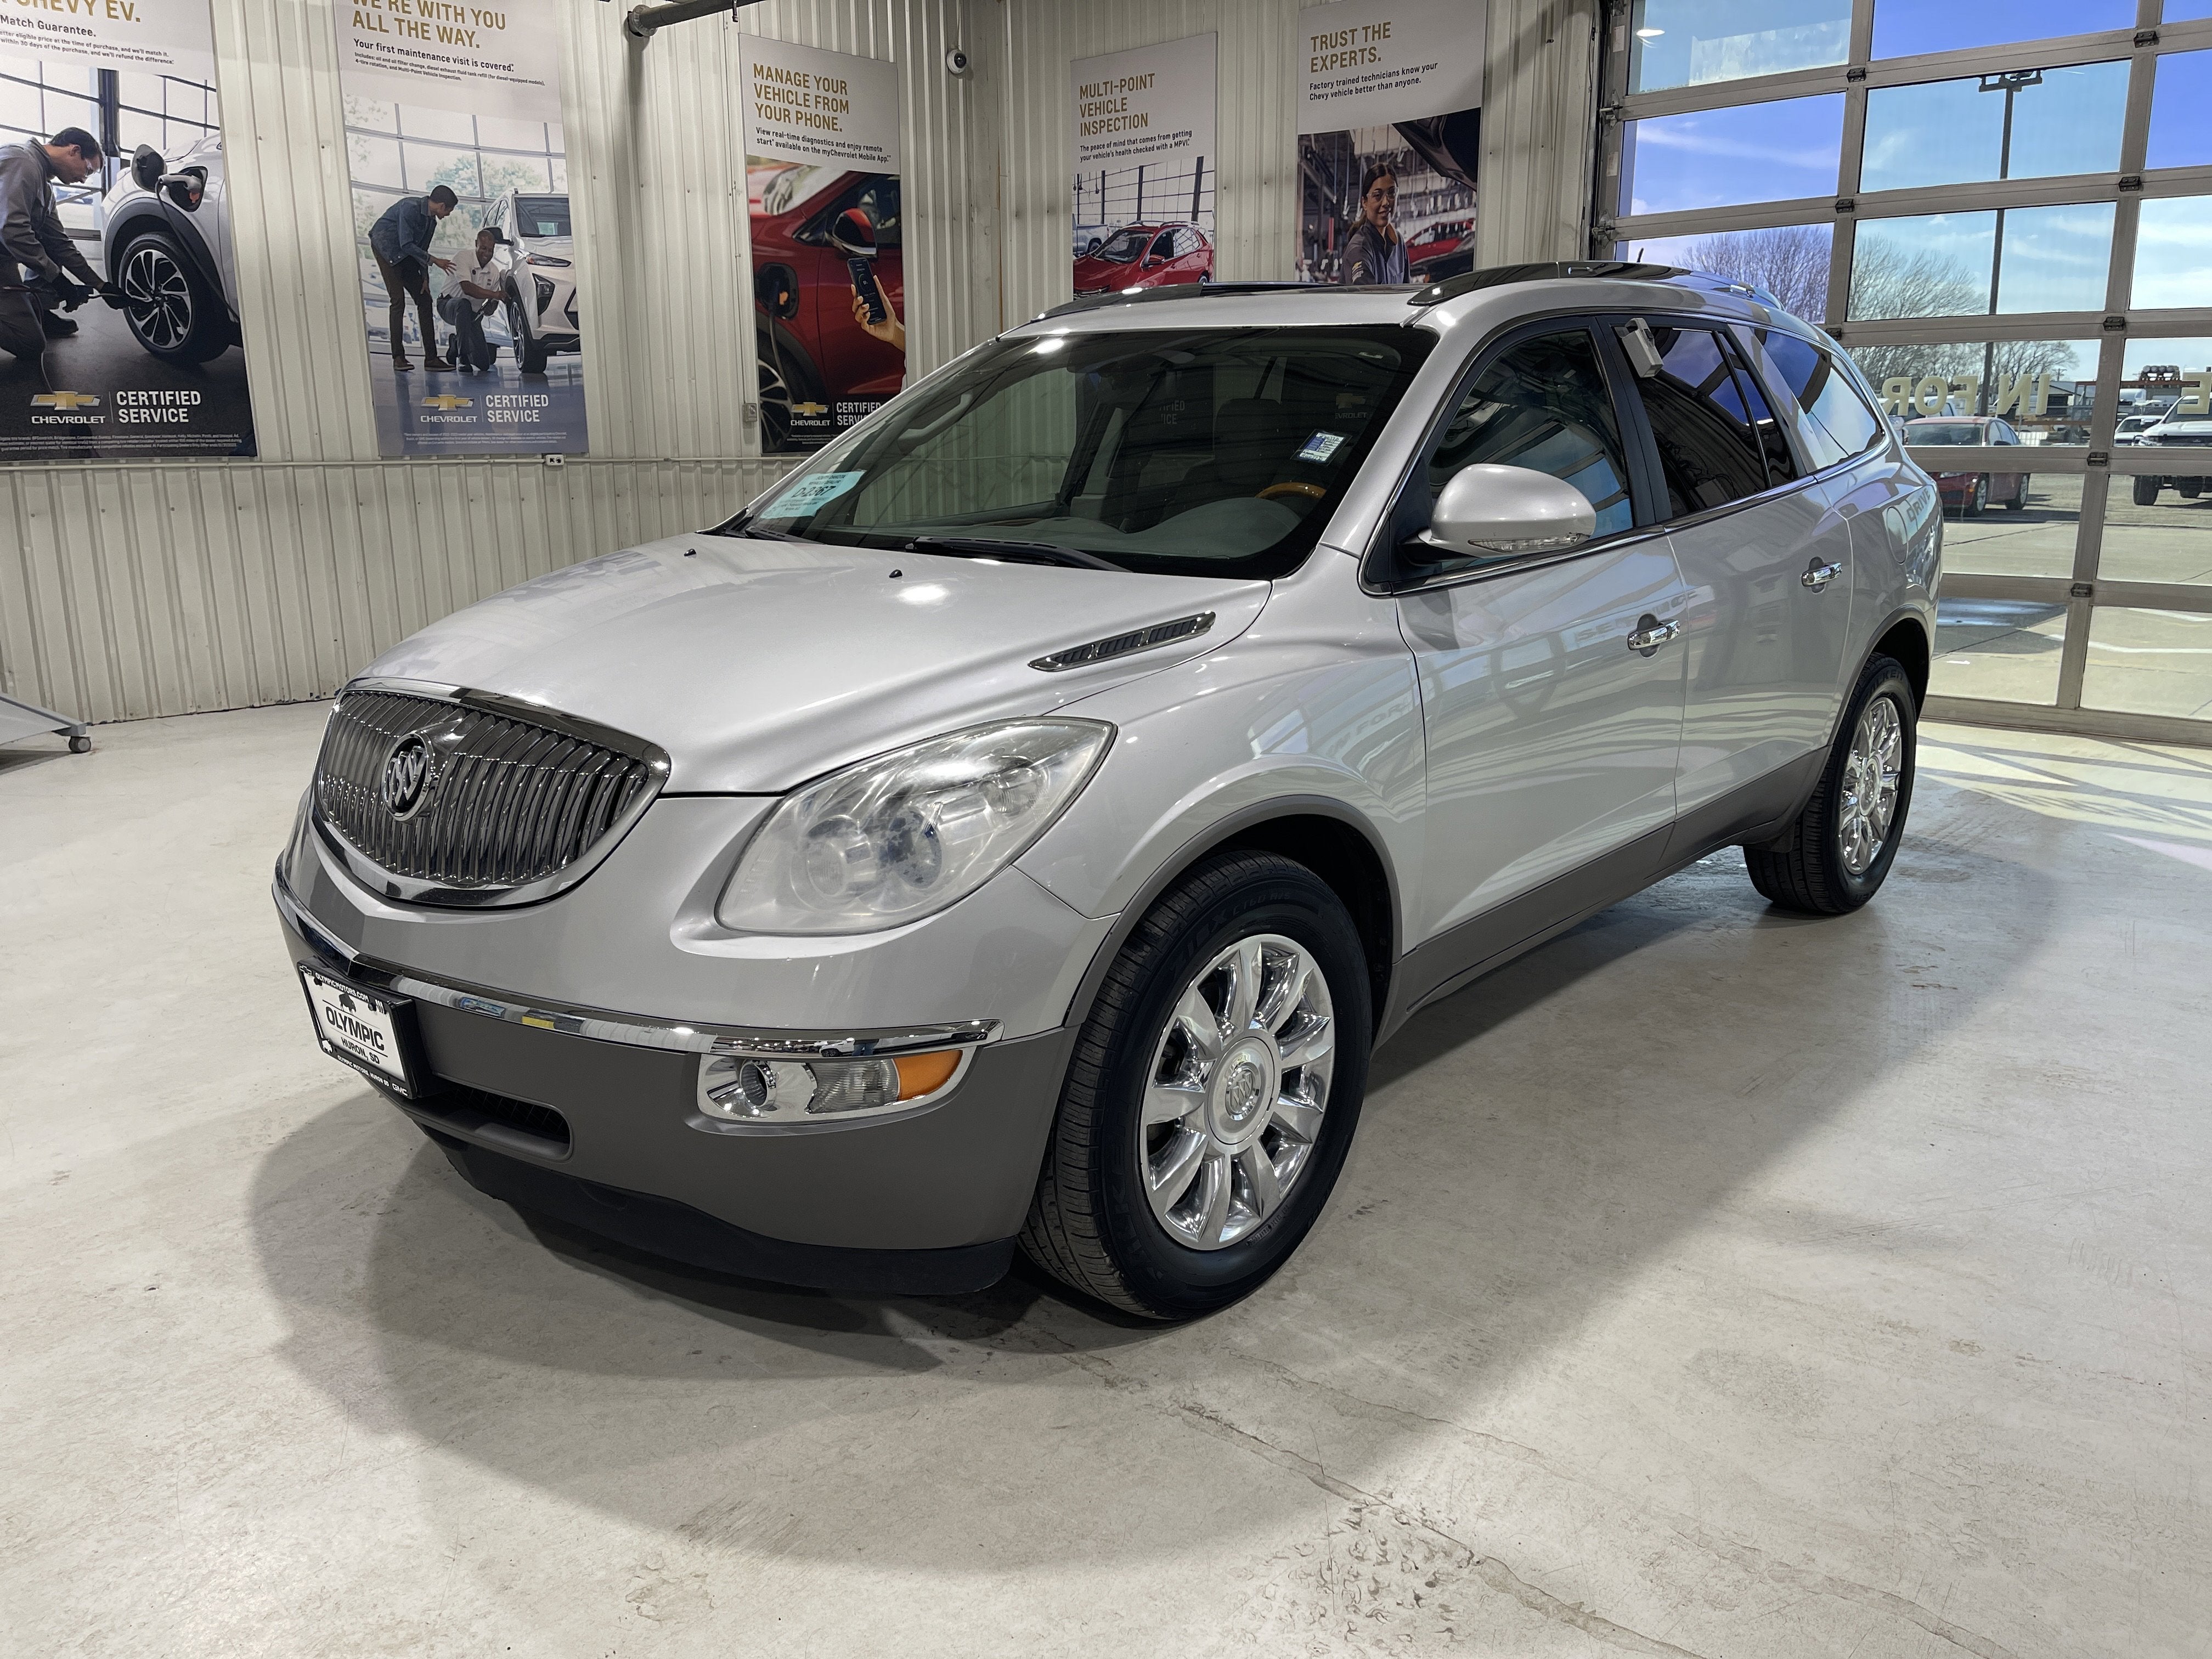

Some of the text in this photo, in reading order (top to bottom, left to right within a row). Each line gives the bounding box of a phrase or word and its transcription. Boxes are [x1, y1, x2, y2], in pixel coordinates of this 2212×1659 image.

[106, 0, 140, 22] EV.
[417, 0, 465, 24] WITH
[471, 8, 506, 30] YOU
[0, 14, 96, 37] Match Guarantee.
[353, 10, 480, 48] ALL THE WAY.
[1310, 21, 1391, 53] TRUST THE
[353, 38, 374, 50] Your
[376, 42, 395, 54] first
[397, 48, 450, 63] maintenance
[452, 56, 470, 66] visit
[472, 58, 478, 67] is
[1310, 46, 1381, 73] EXPERTS.
[753, 63, 848, 95] MANAGE YOUR
[1079, 73, 1155, 100] MULTI-POINT
[1310, 63, 1438, 91] Factory trained technicians know your
[1310, 78, 1421, 101] Chevy vehicle better than anyone.
[753, 83, 849, 115] VEHICLE FROM
[1079, 97, 1127, 118] VEHICLE
[754, 102, 842, 132] YOUR PHONE.
[1080, 112, 1148, 137] INSPECTION
[756, 127, 883, 153] View real-time diagnostics and enjoy remote
[775, 140, 801, 151] available
[811, 145, 821, 155] the
[822, 149, 857, 160] myChevrolet
[859, 152, 876, 161] Mobile
[1080, 154, 1092, 163] your
[1092, 150, 1114, 160] vehicle's
[1115, 146, 1132, 157] health
[1133, 144, 1155, 155] checked
[1156, 142, 1168, 151] with
[1090, 142, 1105, 153] peace
[1106, 140, 1112, 149] of
[1113, 138, 1125, 148] mind
[1127, 137, 1138, 146] that
[1139, 136, 1156, 144] comes
[1158, 133, 1171, 142] from
[1172, 130, 1192, 141] getting
[116, 390, 201, 406] CERTIFIED
[486, 394, 549, 408] CERTIFIED
[31, 415, 106, 424] CHEVROLET
[119, 408, 189, 424] SERVICE
[487, 409, 540, 423] SERVICE
[315, 972, 369, 1002] OLYMPICMOTORS.COM
[325, 1006, 385, 1051] OLYMPIC
[341, 1036, 380, 1064] HURON, SD
[392, 1083, 408, 1096] GMC
